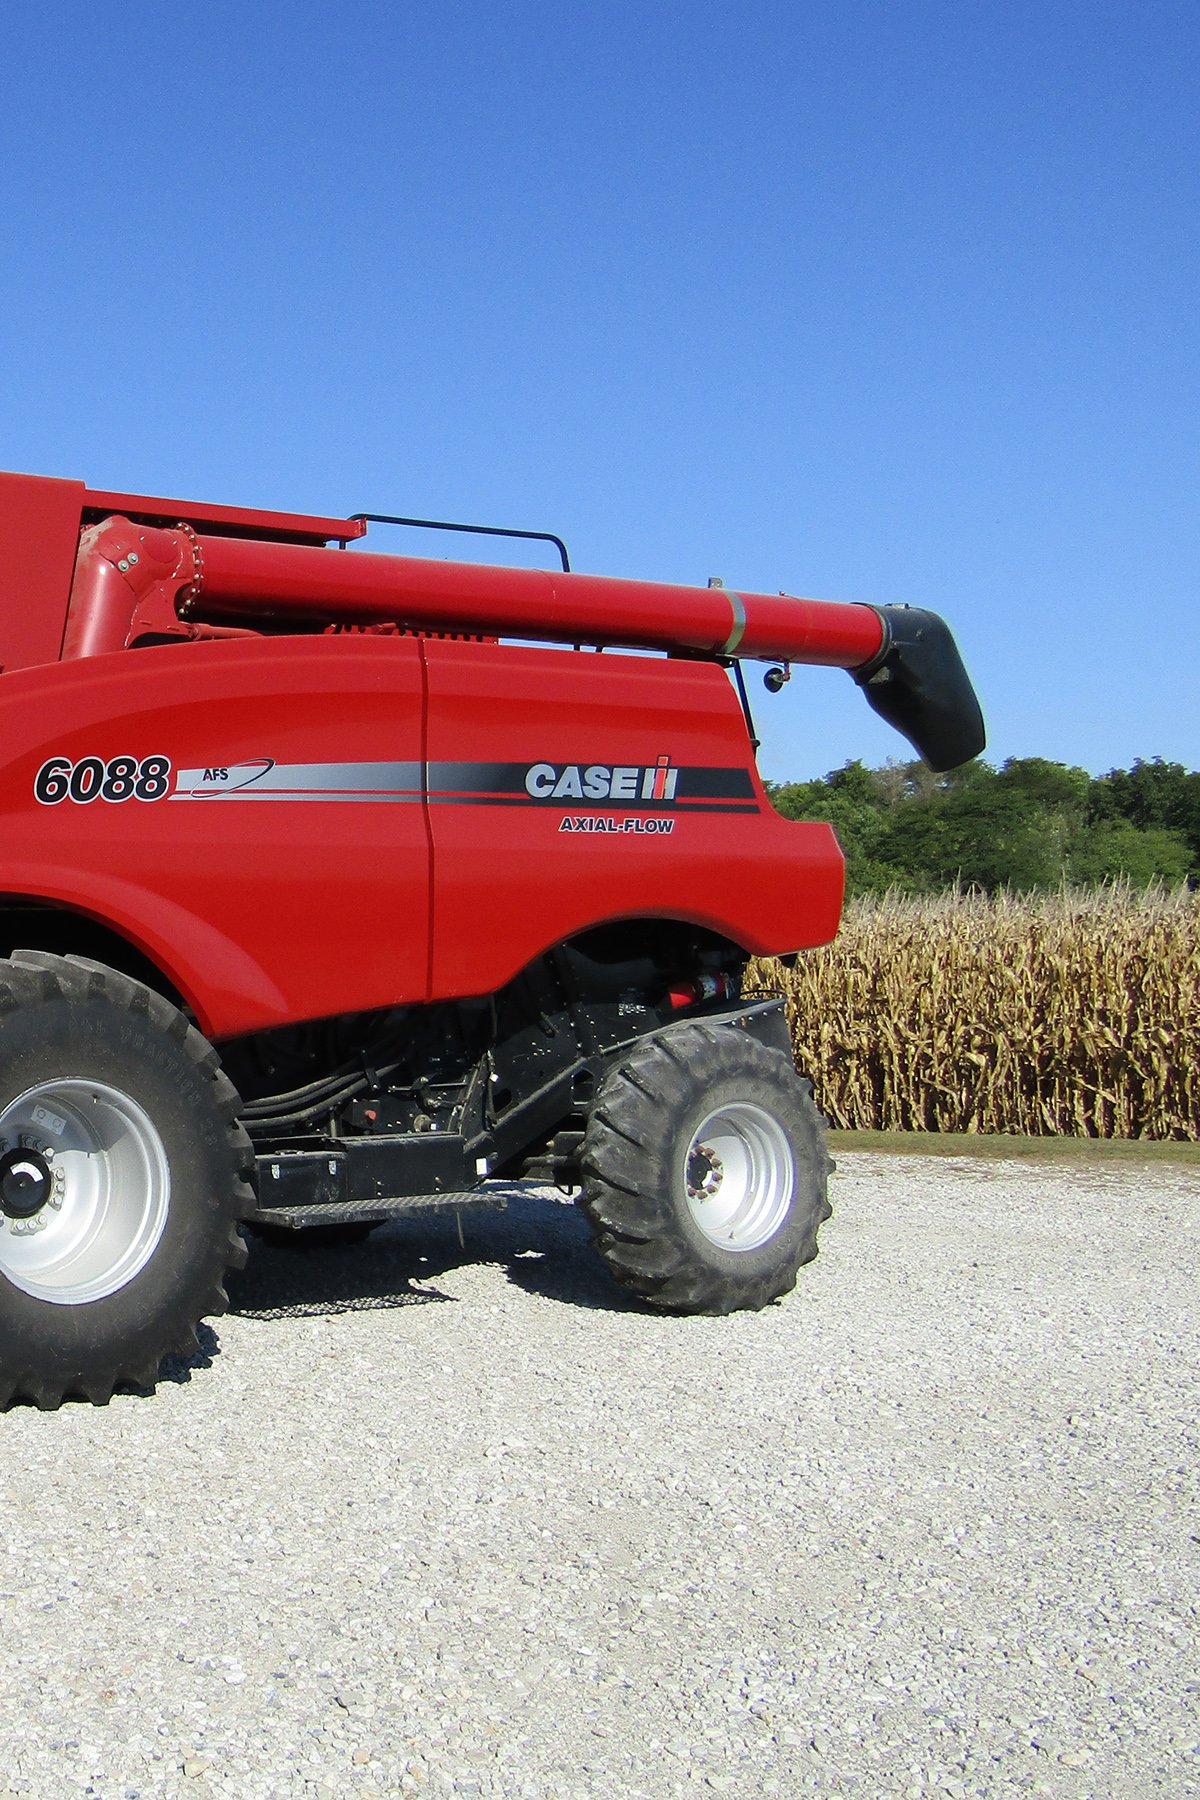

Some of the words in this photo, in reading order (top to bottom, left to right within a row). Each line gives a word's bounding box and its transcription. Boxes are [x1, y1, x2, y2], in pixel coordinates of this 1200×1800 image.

[34, 755, 171, 805] 6088
[203, 768, 228, 781] AFS
[525, 762, 638, 799] CASE
[559, 818, 674, 833] AXIAL-FLOW
